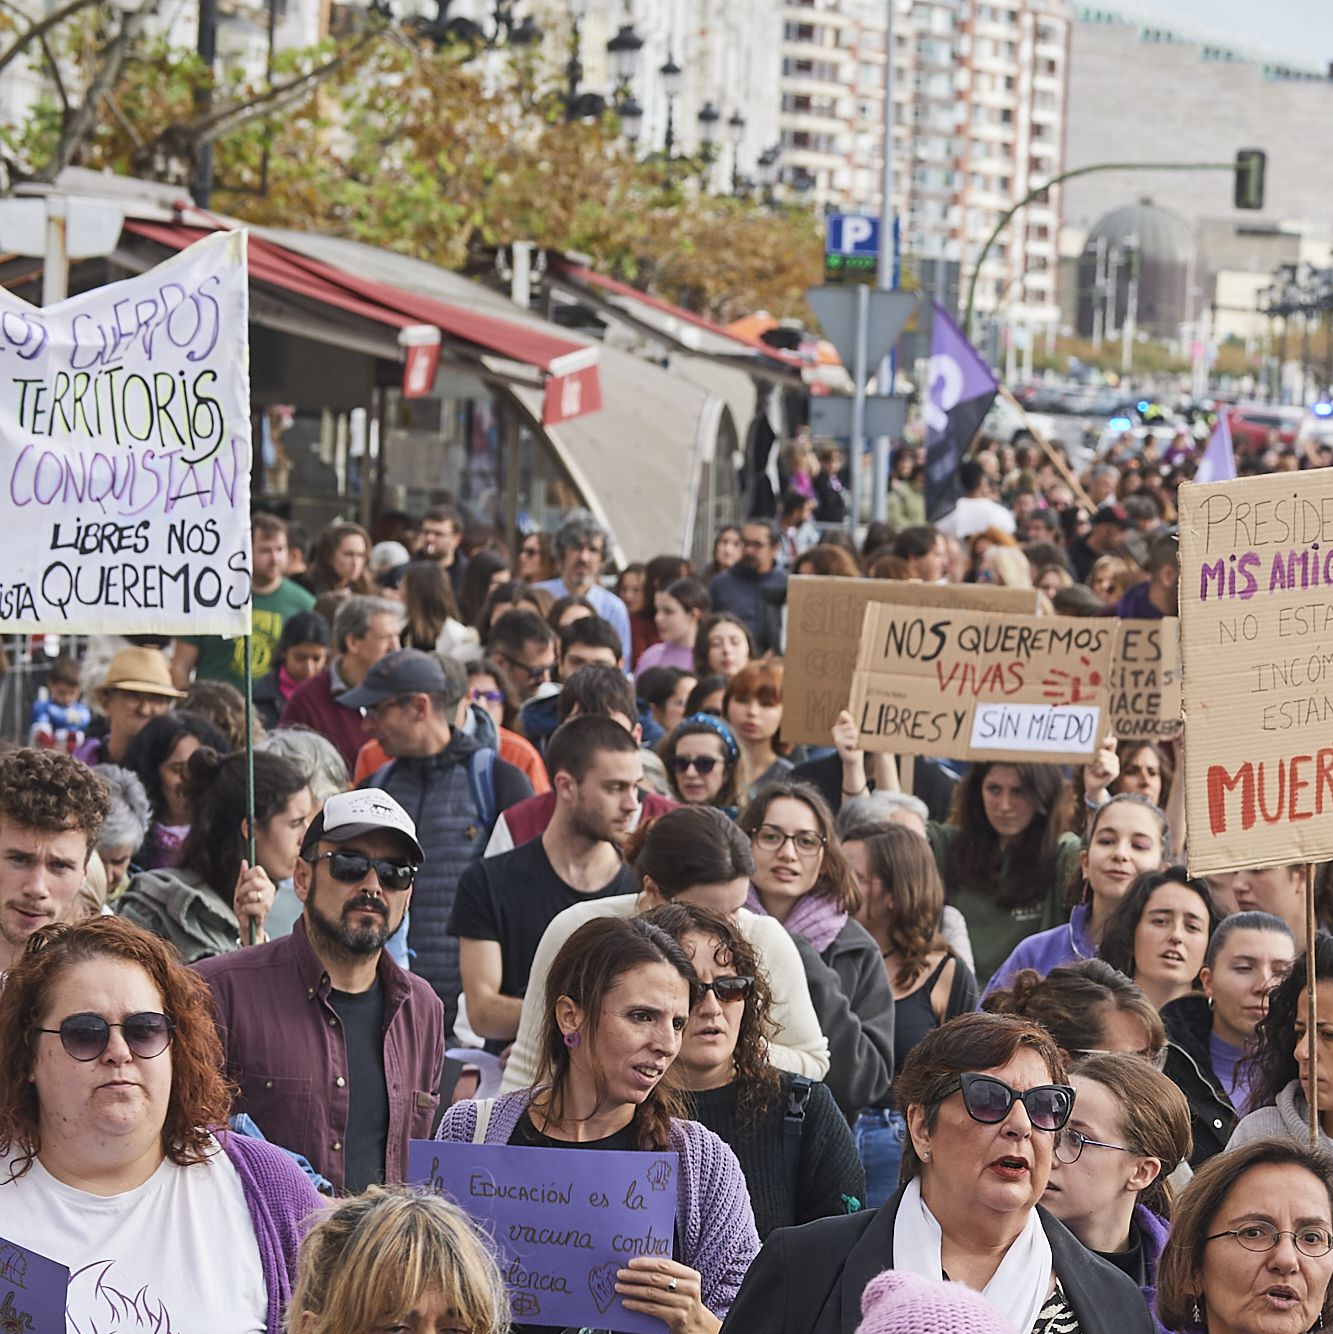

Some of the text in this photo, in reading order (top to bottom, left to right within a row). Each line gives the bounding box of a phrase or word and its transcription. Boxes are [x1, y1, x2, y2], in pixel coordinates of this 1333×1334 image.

[842, 217, 873, 253] P
[50, 517, 220, 555] LIBRES NOS
[42, 551, 252, 619] QUEREMOS
[1200, 551, 1261, 601] MIS
[884, 618, 1108, 664] NOS QUEREMOS
[1219, 614, 1259, 644] NO
[935, 660, 1026, 696] VIVAS
[860, 701, 947, 741] LIBRES
[952, 709, 966, 738] Y
[980, 704, 1019, 737] SIN
[1027, 707, 1095, 744] MIEDO
[588, 1191, 609, 1208] es
[622, 1181, 648, 1210] la
[509, 1224, 670, 1256] vacuna contra
